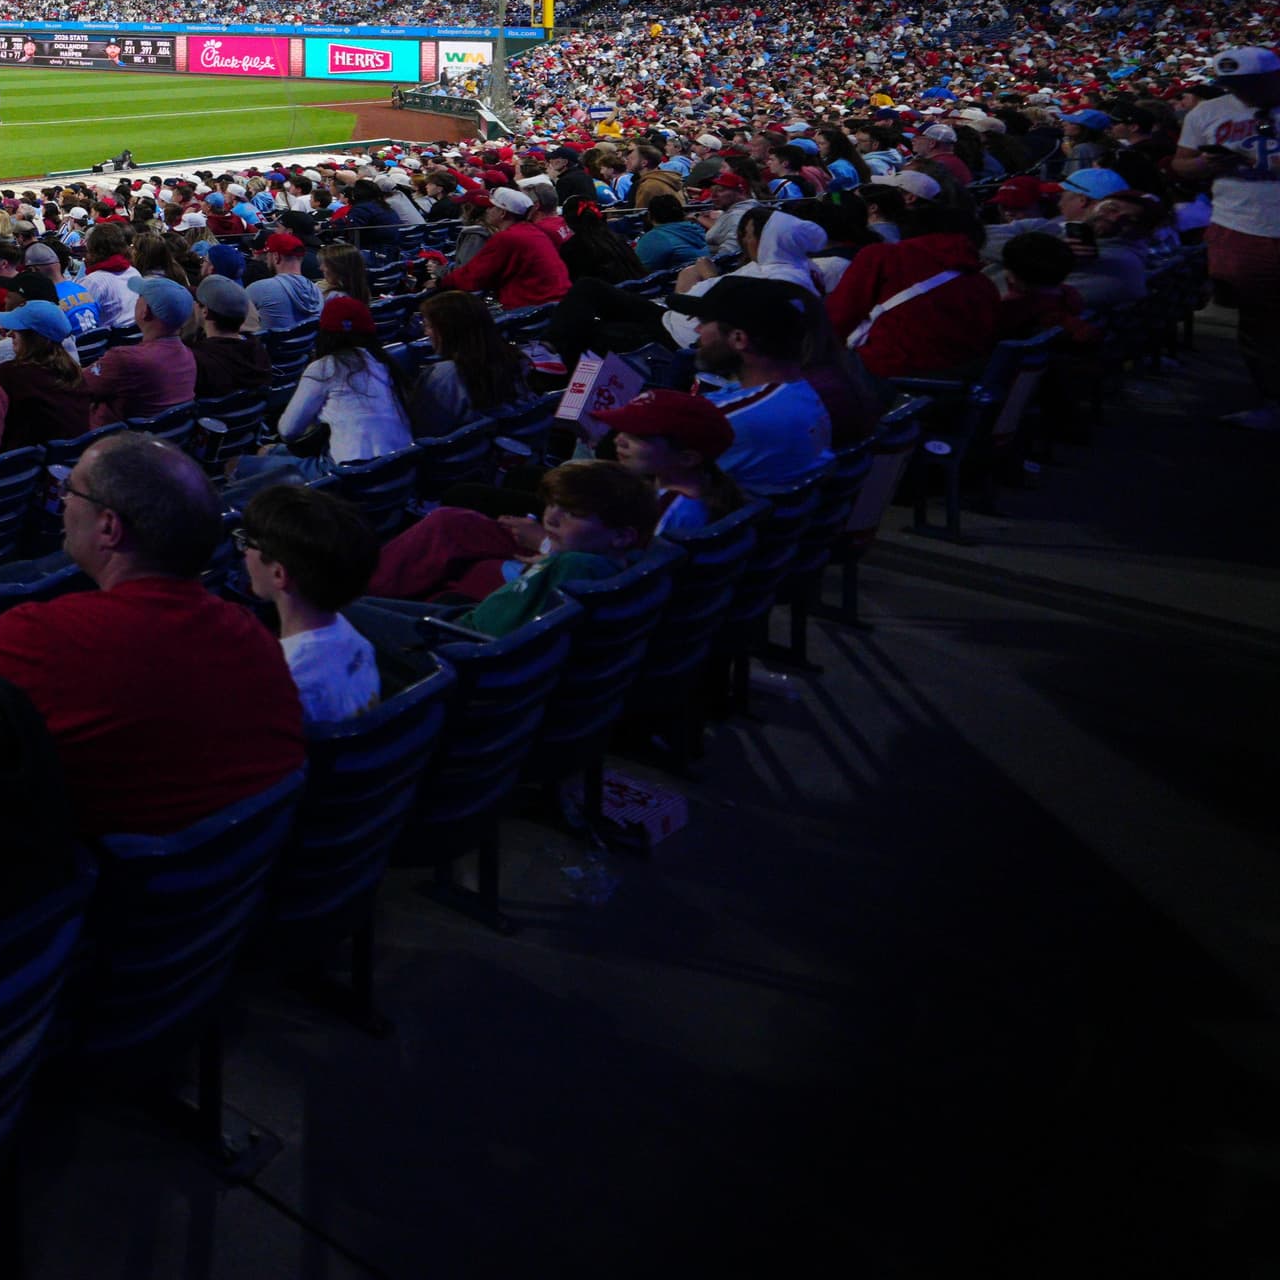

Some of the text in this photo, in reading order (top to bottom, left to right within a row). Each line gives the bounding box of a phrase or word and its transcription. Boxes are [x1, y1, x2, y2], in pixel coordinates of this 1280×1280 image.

[200, 45, 276, 71] Chick-fil-A
[334, 50, 385, 69] HERR'S
[445, 51, 486, 64] WM
